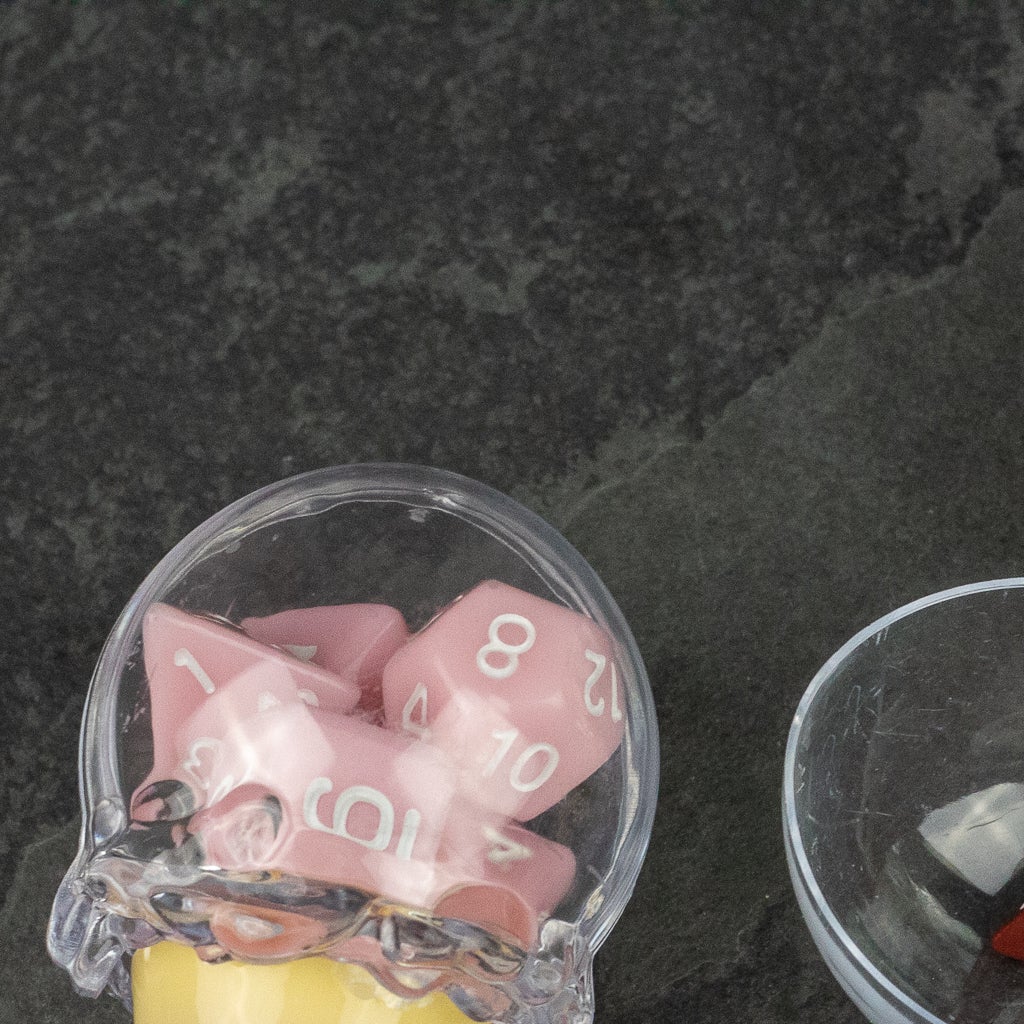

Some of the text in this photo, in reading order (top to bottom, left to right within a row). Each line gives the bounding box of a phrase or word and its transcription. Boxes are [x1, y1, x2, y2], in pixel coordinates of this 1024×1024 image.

[174, 648, 216, 694] 1
[476, 613, 536, 679] 8
[482, 727, 560, 793] 10
